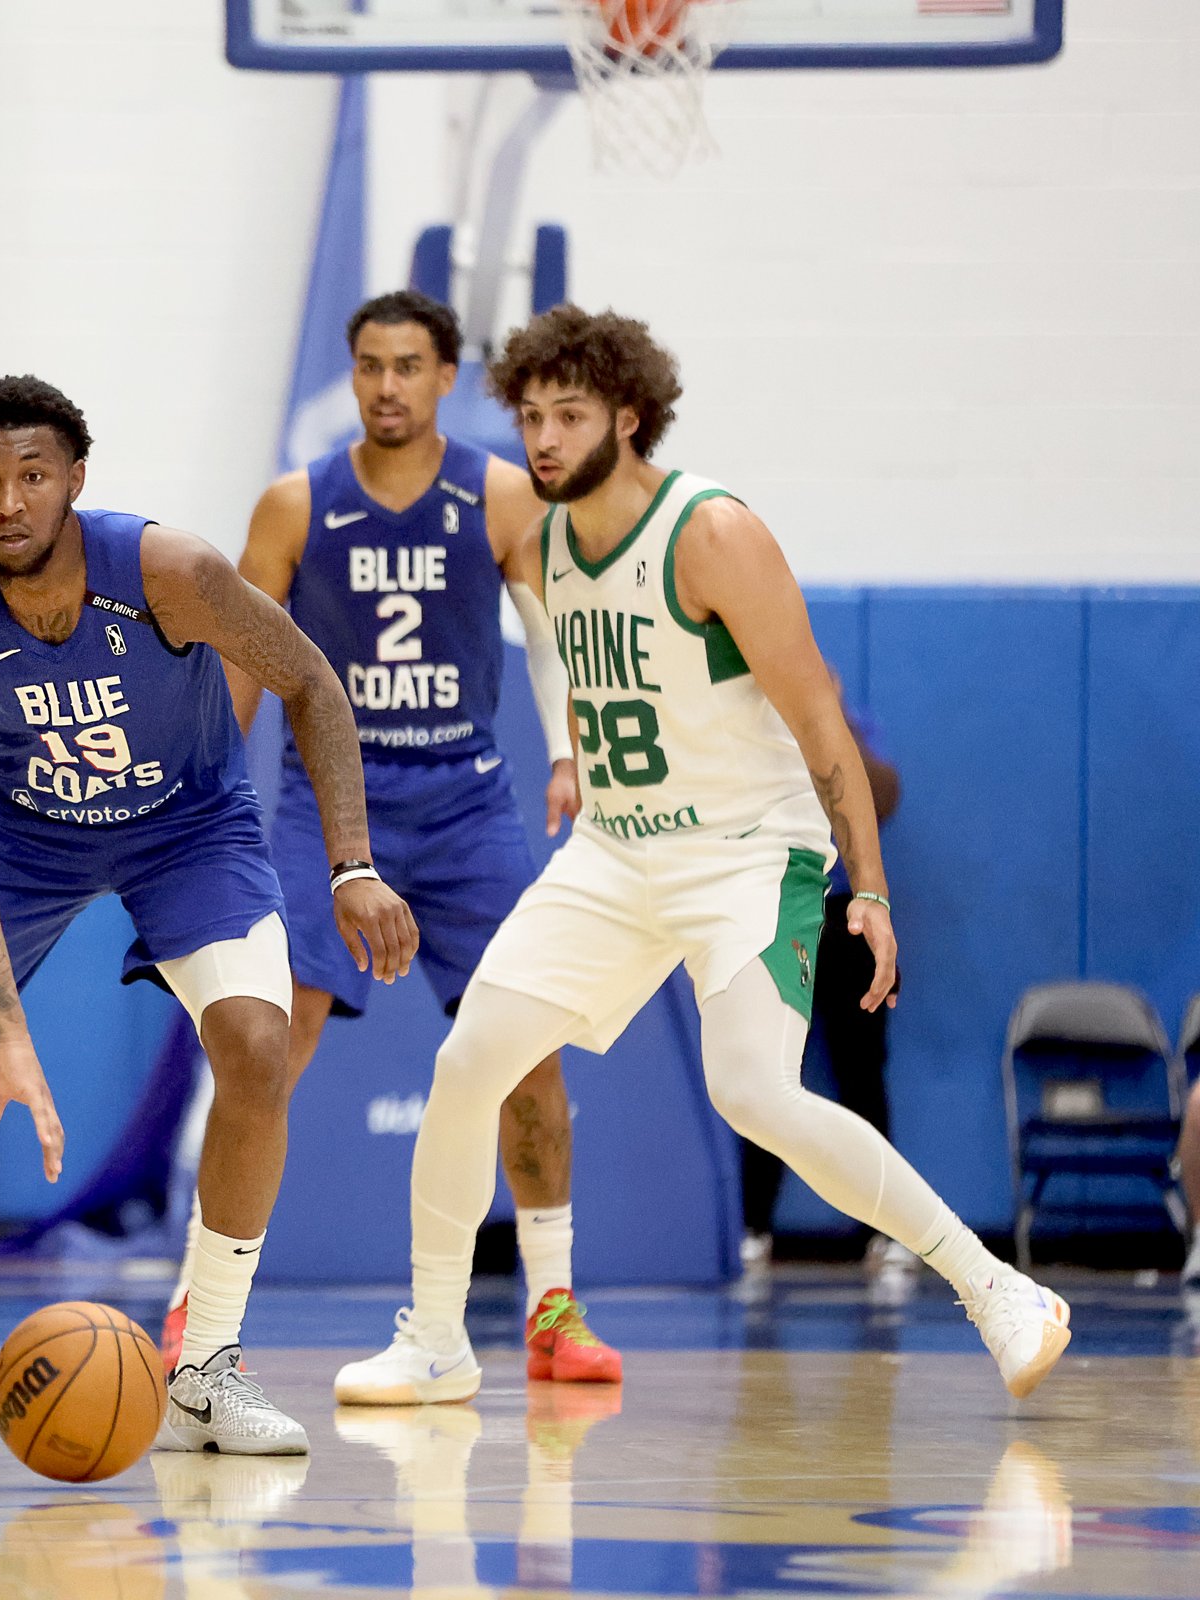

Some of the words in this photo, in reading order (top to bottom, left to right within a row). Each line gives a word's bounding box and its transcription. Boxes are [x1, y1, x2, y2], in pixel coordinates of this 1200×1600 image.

[351, 545, 447, 593] BLUE
[92, 595, 113, 610] BIG
[111, 602, 140, 620] MIKE
[376, 593, 423, 662] 2
[14, 675, 130, 727] BLUE
[347, 663, 460, 710] COATS
[39, 723, 132, 772] 19
[358, 720, 474, 747] crypto.com
[572, 699, 669, 789] 28
[27, 756, 164, 804] COATS
[46, 778, 183, 825] crypto.com
[592, 801, 704, 841] Amica
